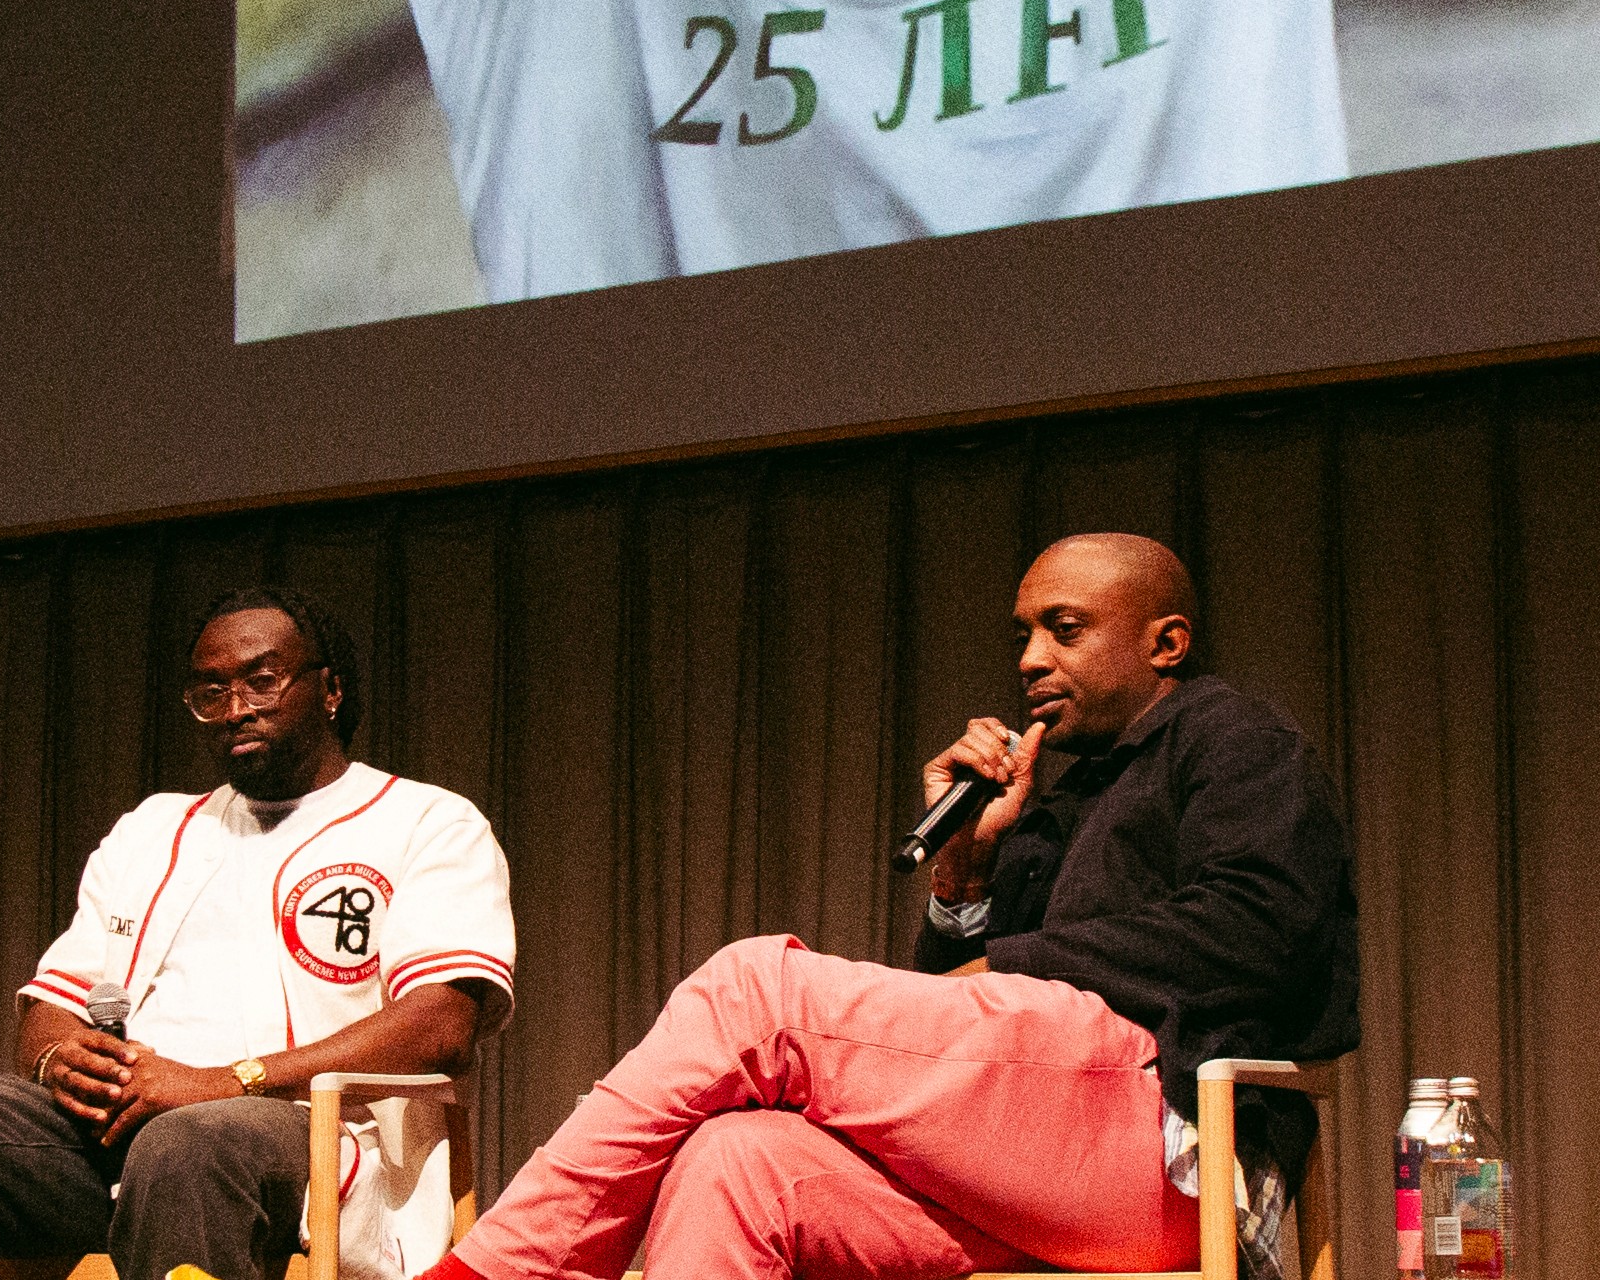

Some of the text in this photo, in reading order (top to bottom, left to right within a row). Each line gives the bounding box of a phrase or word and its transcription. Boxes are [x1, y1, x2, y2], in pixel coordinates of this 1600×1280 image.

[649, 8, 826, 146] 25
[284, 891, 300, 918] FORTY
[297, 872, 324, 891] ACRES
[326, 865, 344, 876] AND
[346, 864, 353, 873] A
[355, 865, 380, 883] MULE
[295, 948, 335, 979] SUPREME
[337, 969, 358, 981] NEW
